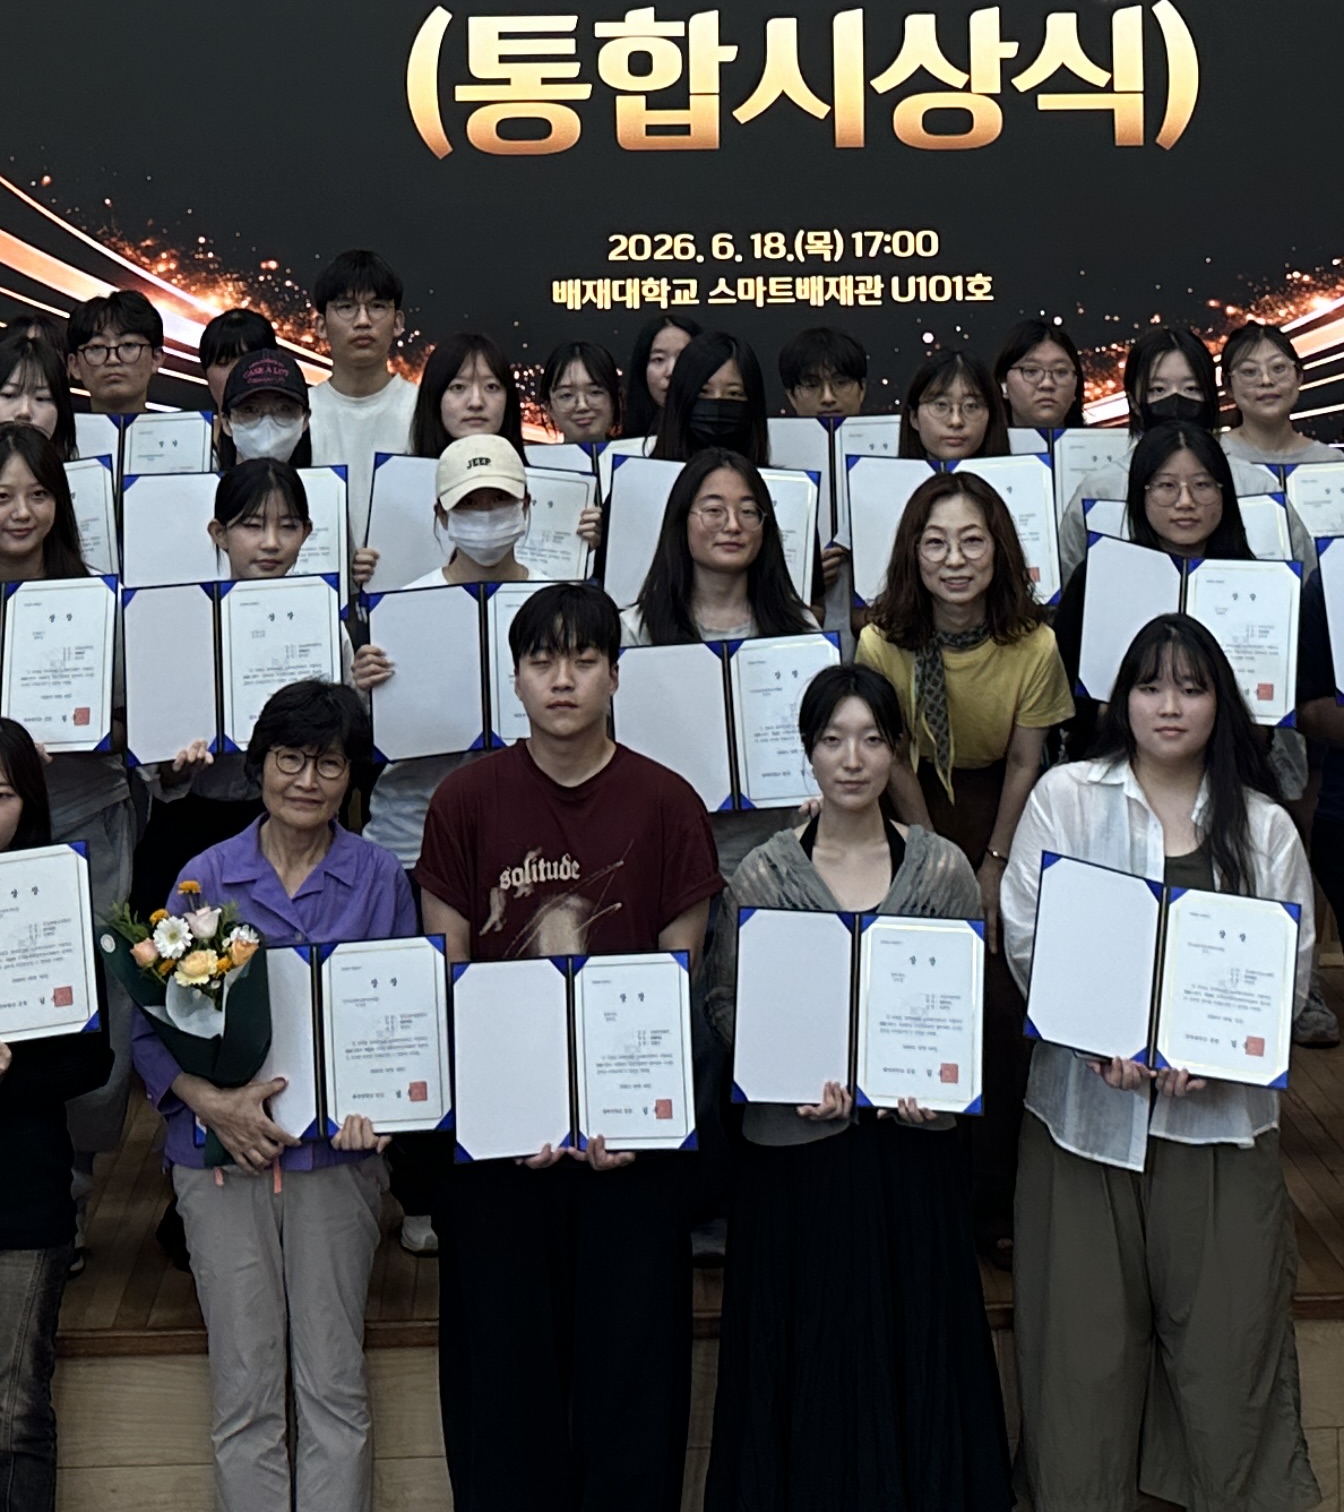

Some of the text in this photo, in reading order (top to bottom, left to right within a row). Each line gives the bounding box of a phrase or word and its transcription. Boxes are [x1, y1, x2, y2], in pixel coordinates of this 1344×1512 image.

[608, 229, 939, 262] 2026. 6. 18.(목) 17:00
[552, 273, 994, 310] 배재대학교 스마트배재관 U101호
[467, 456, 492, 470] JEEP
[499, 850, 581, 890] solitude
